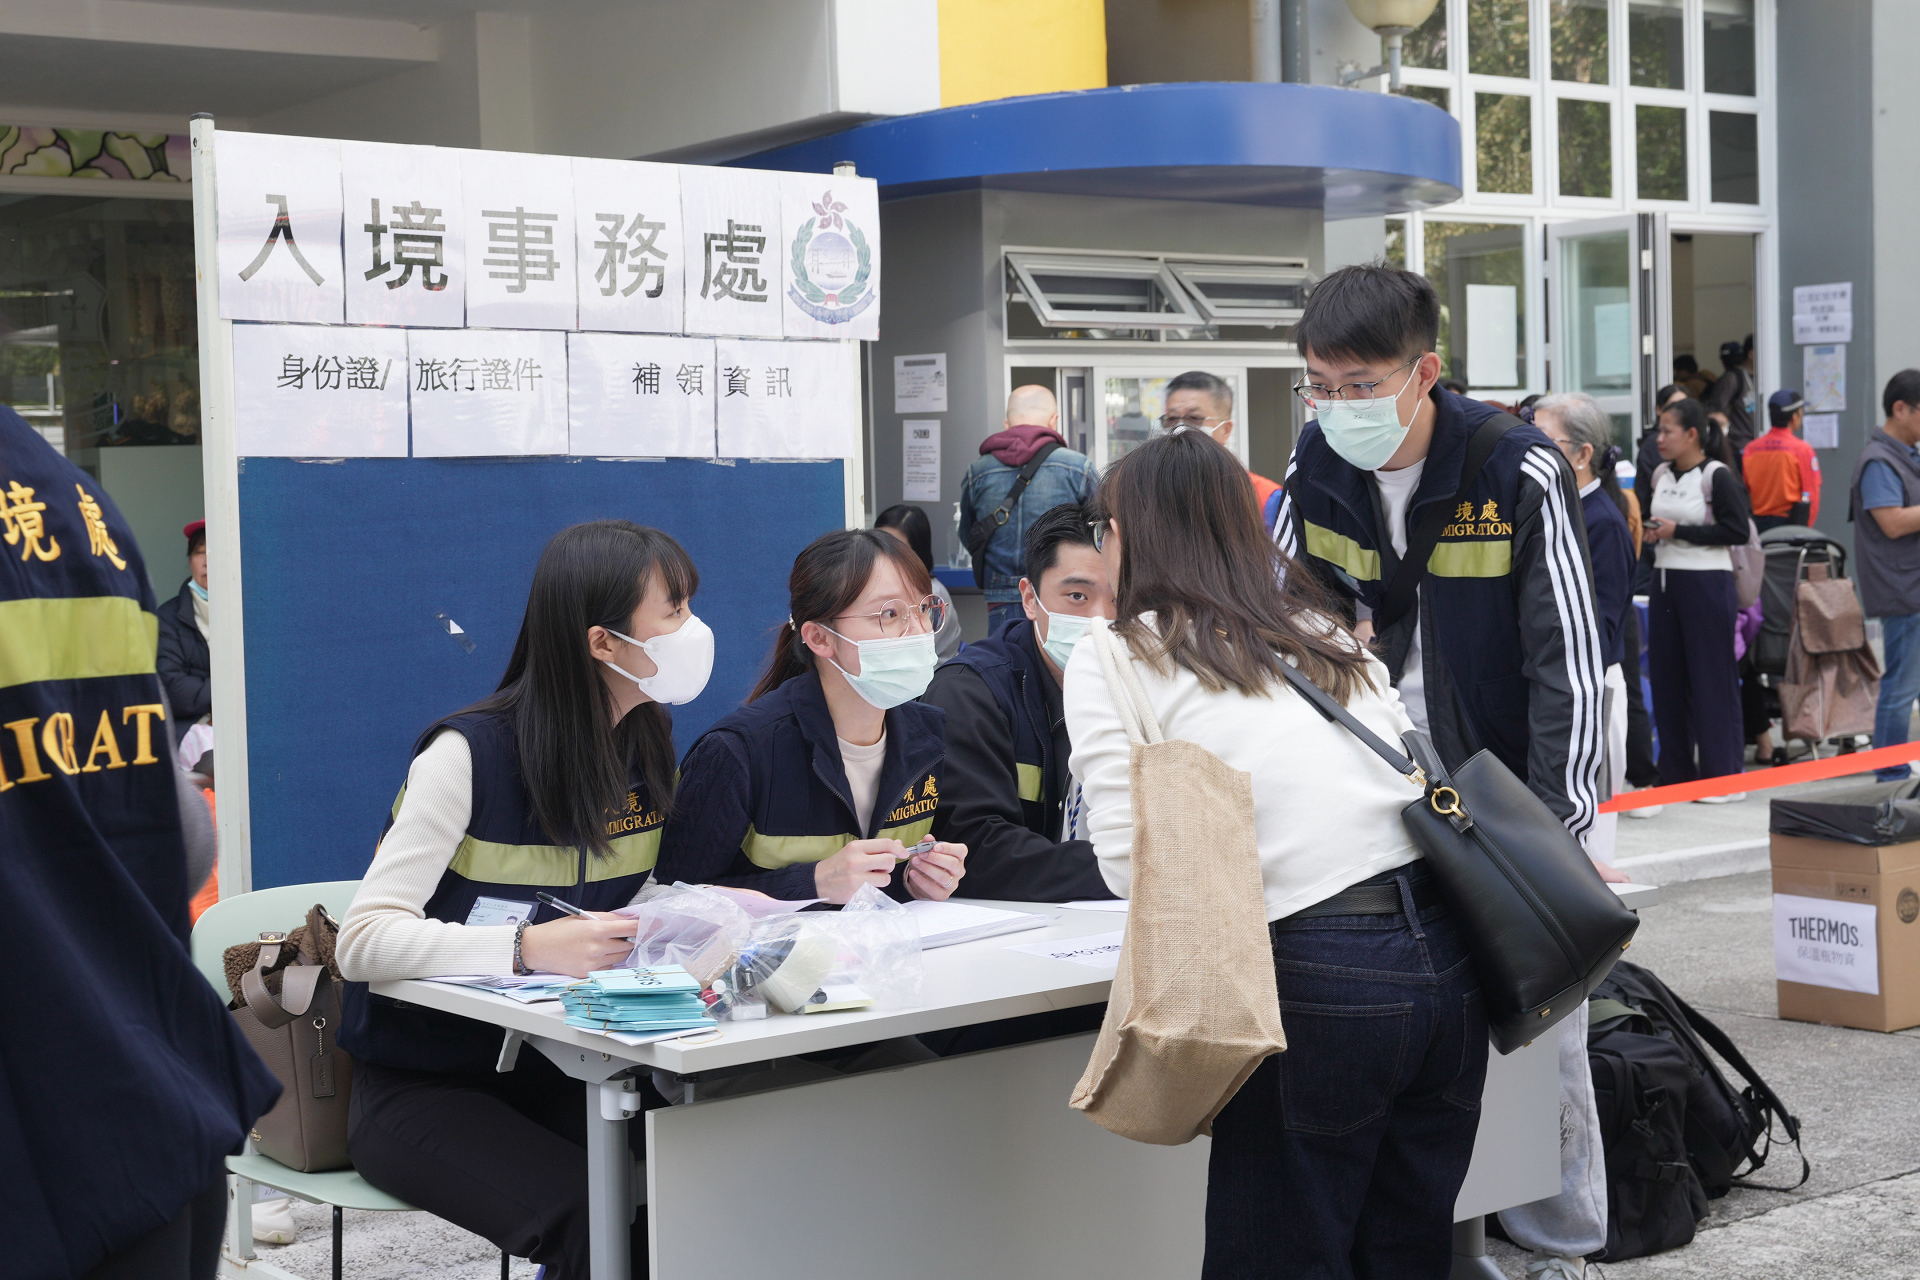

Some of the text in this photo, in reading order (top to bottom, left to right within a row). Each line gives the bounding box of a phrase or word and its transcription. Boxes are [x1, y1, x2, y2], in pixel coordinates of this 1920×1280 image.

[238, 194, 769, 303] 入境事務處
